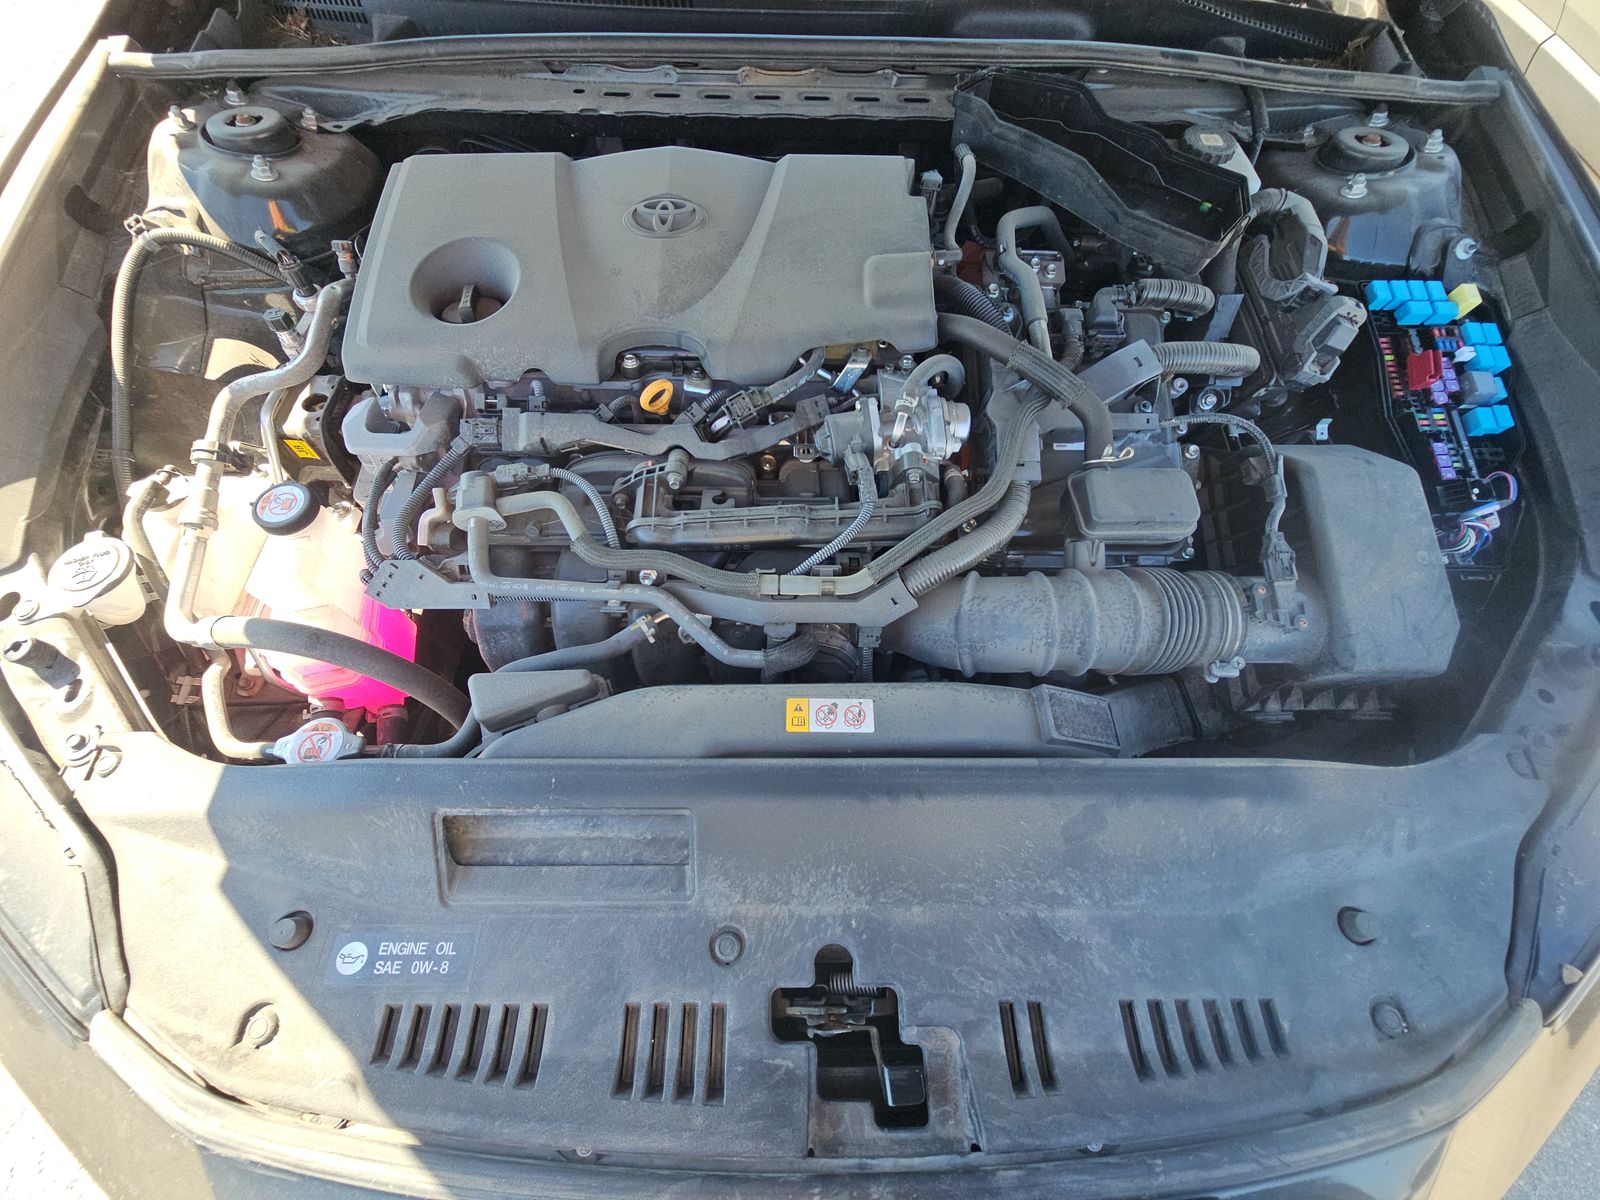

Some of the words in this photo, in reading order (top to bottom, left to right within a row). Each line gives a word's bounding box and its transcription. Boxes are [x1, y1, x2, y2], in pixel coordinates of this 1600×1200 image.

[378, 941, 429, 955] ENGINE
[435, 941, 457, 955] OIL
[373, 960, 403, 975] SAE
